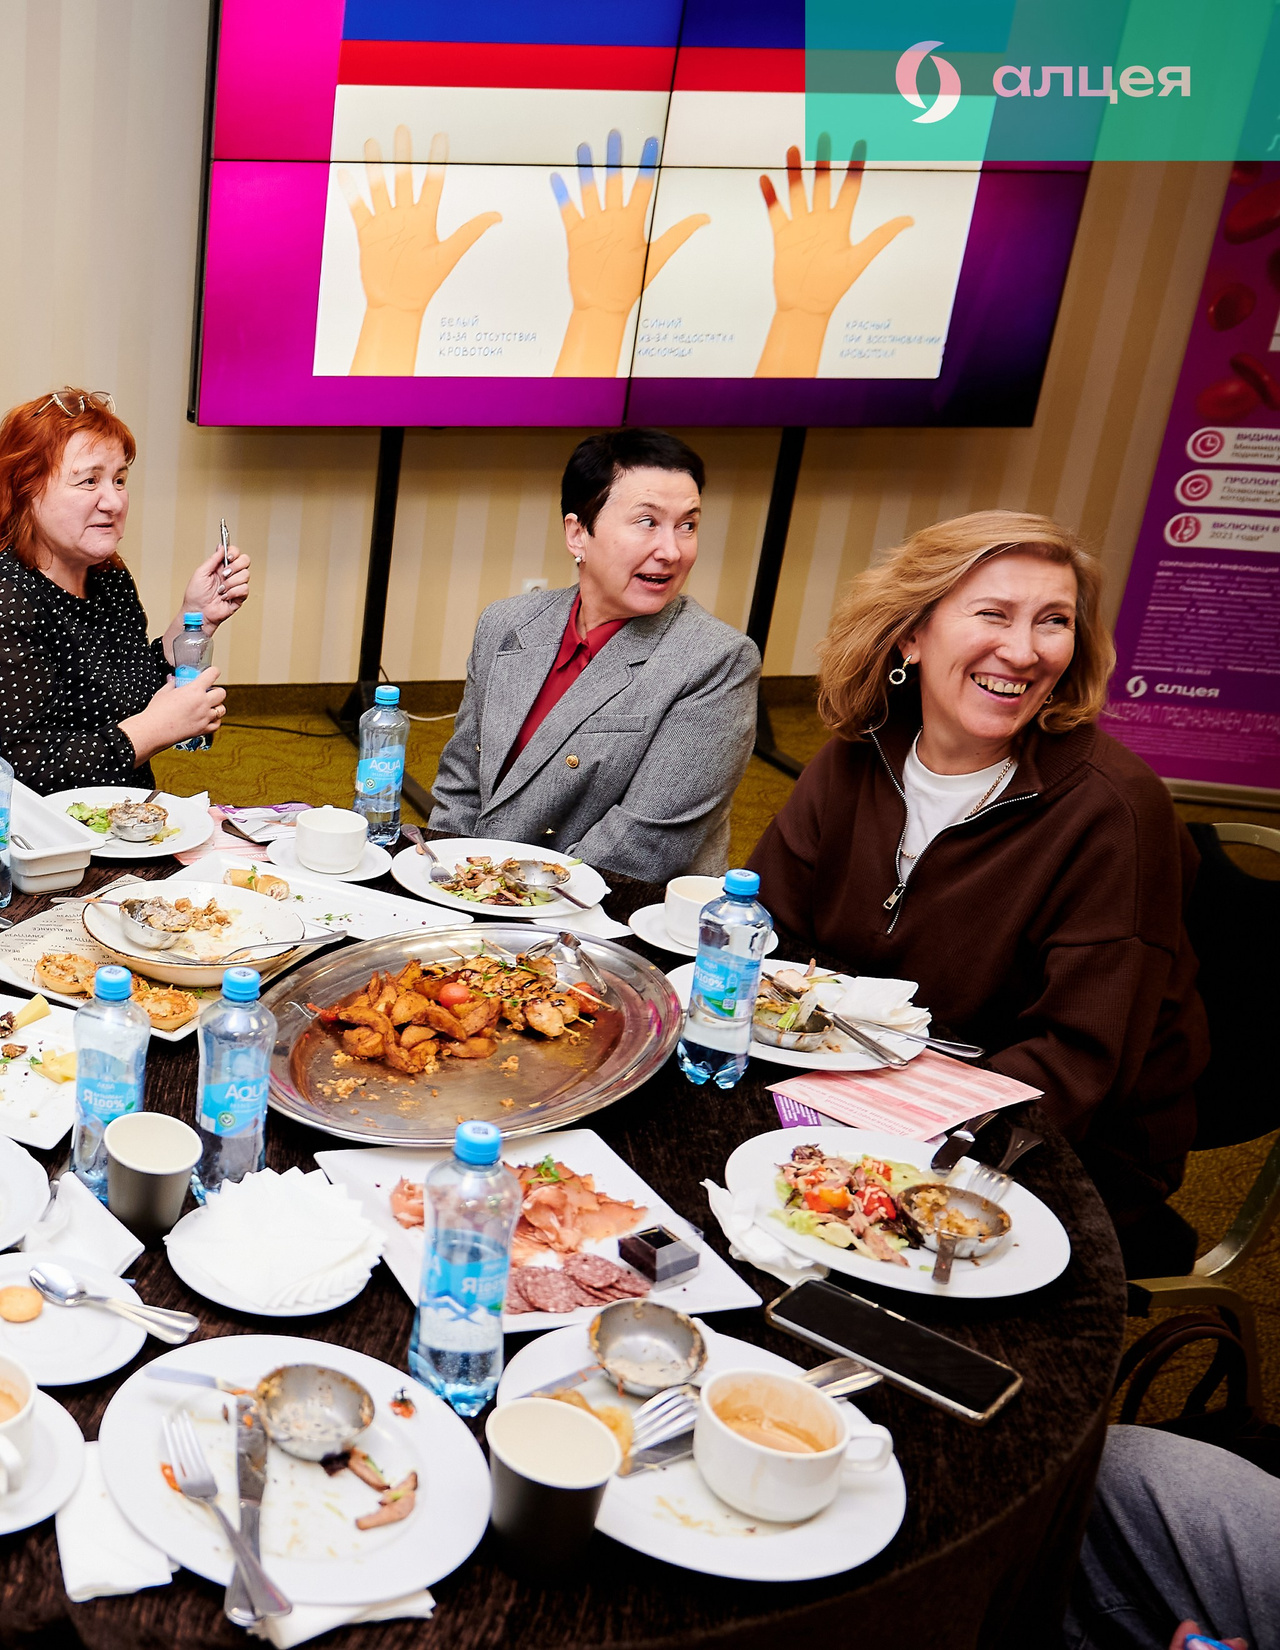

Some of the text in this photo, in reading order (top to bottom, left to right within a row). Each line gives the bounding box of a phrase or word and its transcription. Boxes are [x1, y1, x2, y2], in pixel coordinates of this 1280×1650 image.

[439, 332, 537, 342] ИЗ-ЗА ОТСУТСТВИЯ
[439, 346, 503, 356] КРОВОТОКА
[1154, 682, 1220, 698] алцея
[370, 760, 401, 773] AQUA
[700, 973, 725, 989] 100%
[93, 1097, 125, 1108] 100%
[460, 1277, 477, 1294] Я
